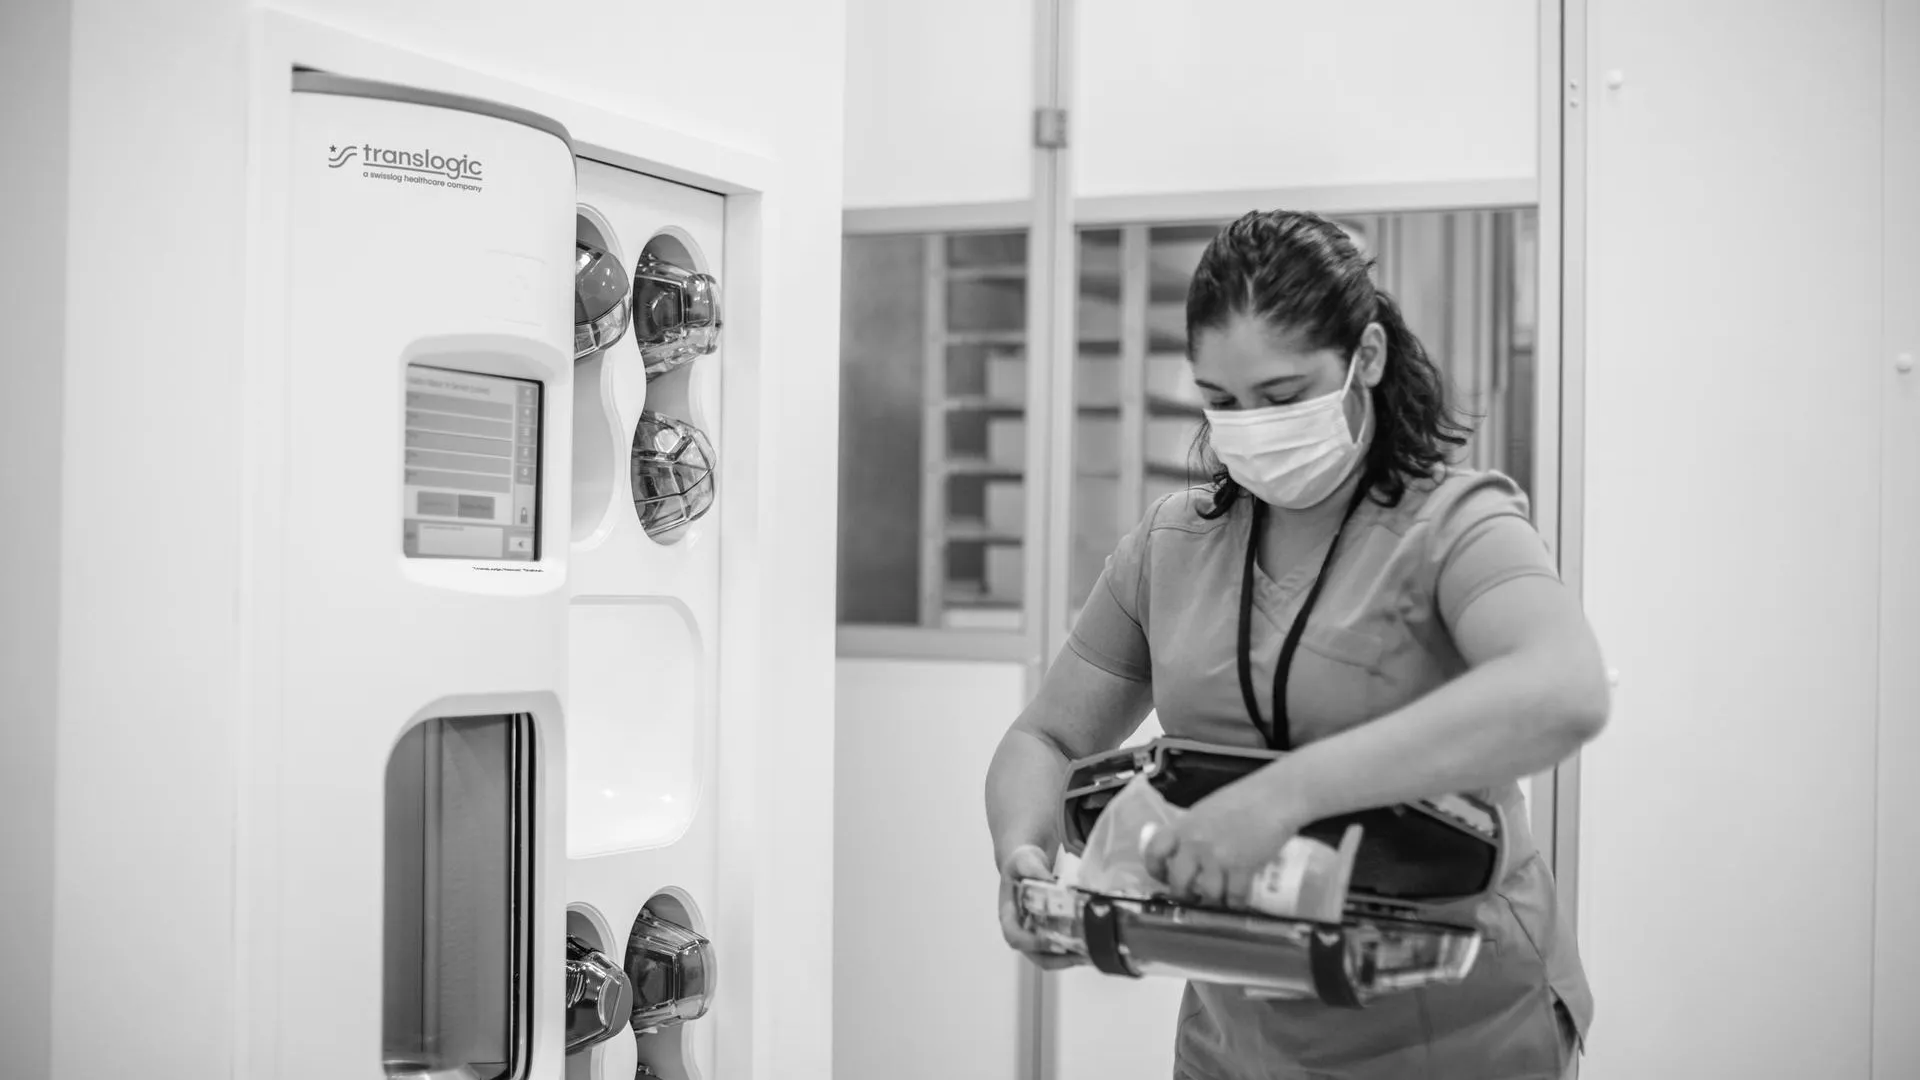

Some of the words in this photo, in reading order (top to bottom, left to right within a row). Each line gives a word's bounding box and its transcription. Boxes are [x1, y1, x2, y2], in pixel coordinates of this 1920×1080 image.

[363, 144, 482, 180] translogic
[370, 172, 403, 183] swisslog
[404, 175, 445, 186] healthcare
[447, 181, 482, 192] company
